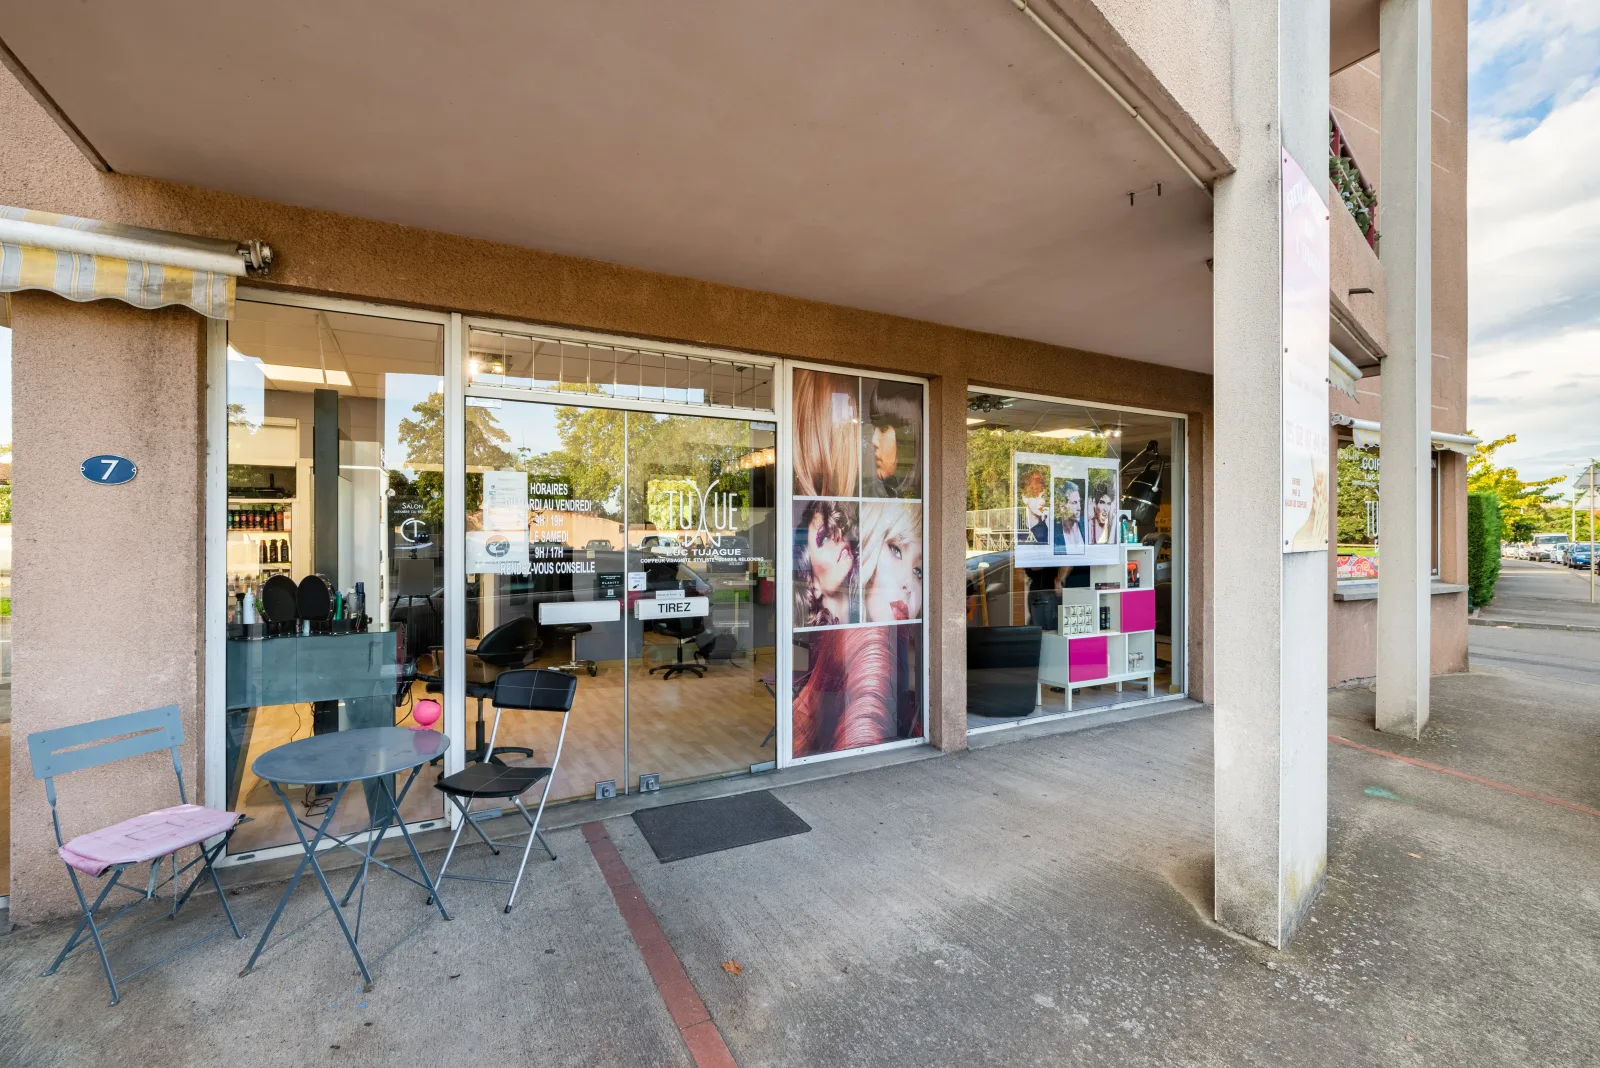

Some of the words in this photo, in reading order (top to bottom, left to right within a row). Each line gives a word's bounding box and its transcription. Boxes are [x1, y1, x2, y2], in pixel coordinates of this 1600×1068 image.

[100, 459, 119, 480] 7
[530, 483, 568, 495] HORAIRES
[543, 500, 554, 511] AU
[556, 500, 592, 511] VENDREDI
[529, 531, 539, 542] LE
[539, 531, 569, 542] SAMEDI
[534, 547, 545, 559] 9H
[550, 547, 564, 558] 17H
[691, 548, 741, 556] TUJAGUE
[500, 562, 554, 576] RENDEZ-VOUS
[555, 561, 596, 574] CONSEILLE
[657, 602, 691, 613] TIREZ
